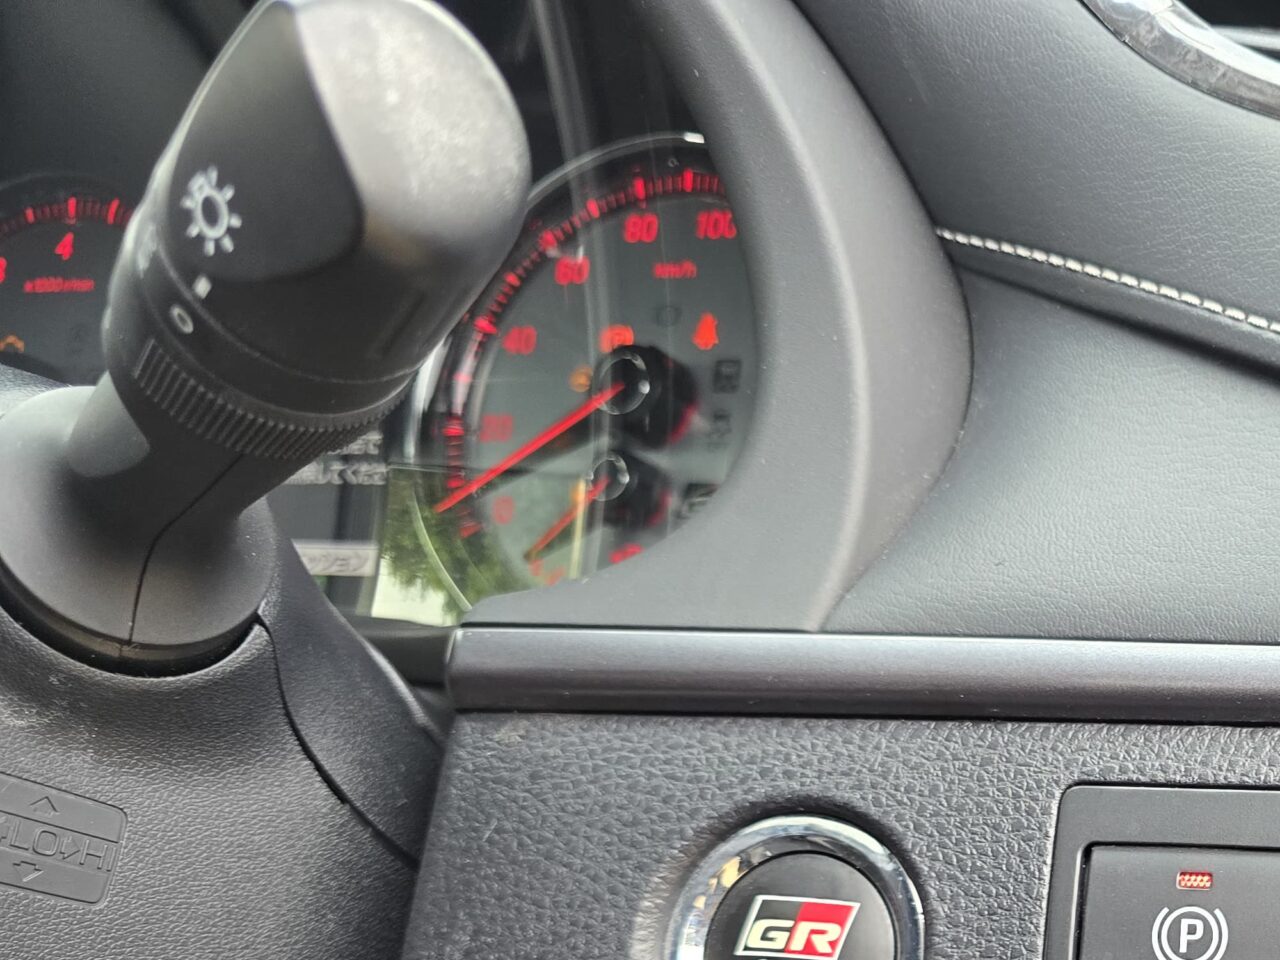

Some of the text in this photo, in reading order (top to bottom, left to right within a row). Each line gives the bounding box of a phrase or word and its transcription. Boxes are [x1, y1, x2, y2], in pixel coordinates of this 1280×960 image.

[624, 213, 659, 244] 80
[54, 231, 75, 261] 4
[555, 255, 591, 286] 60
[503, 324, 538, 355] 40
[746, 918, 842, 954] GR
[1179, 917, 1205, 953] P
